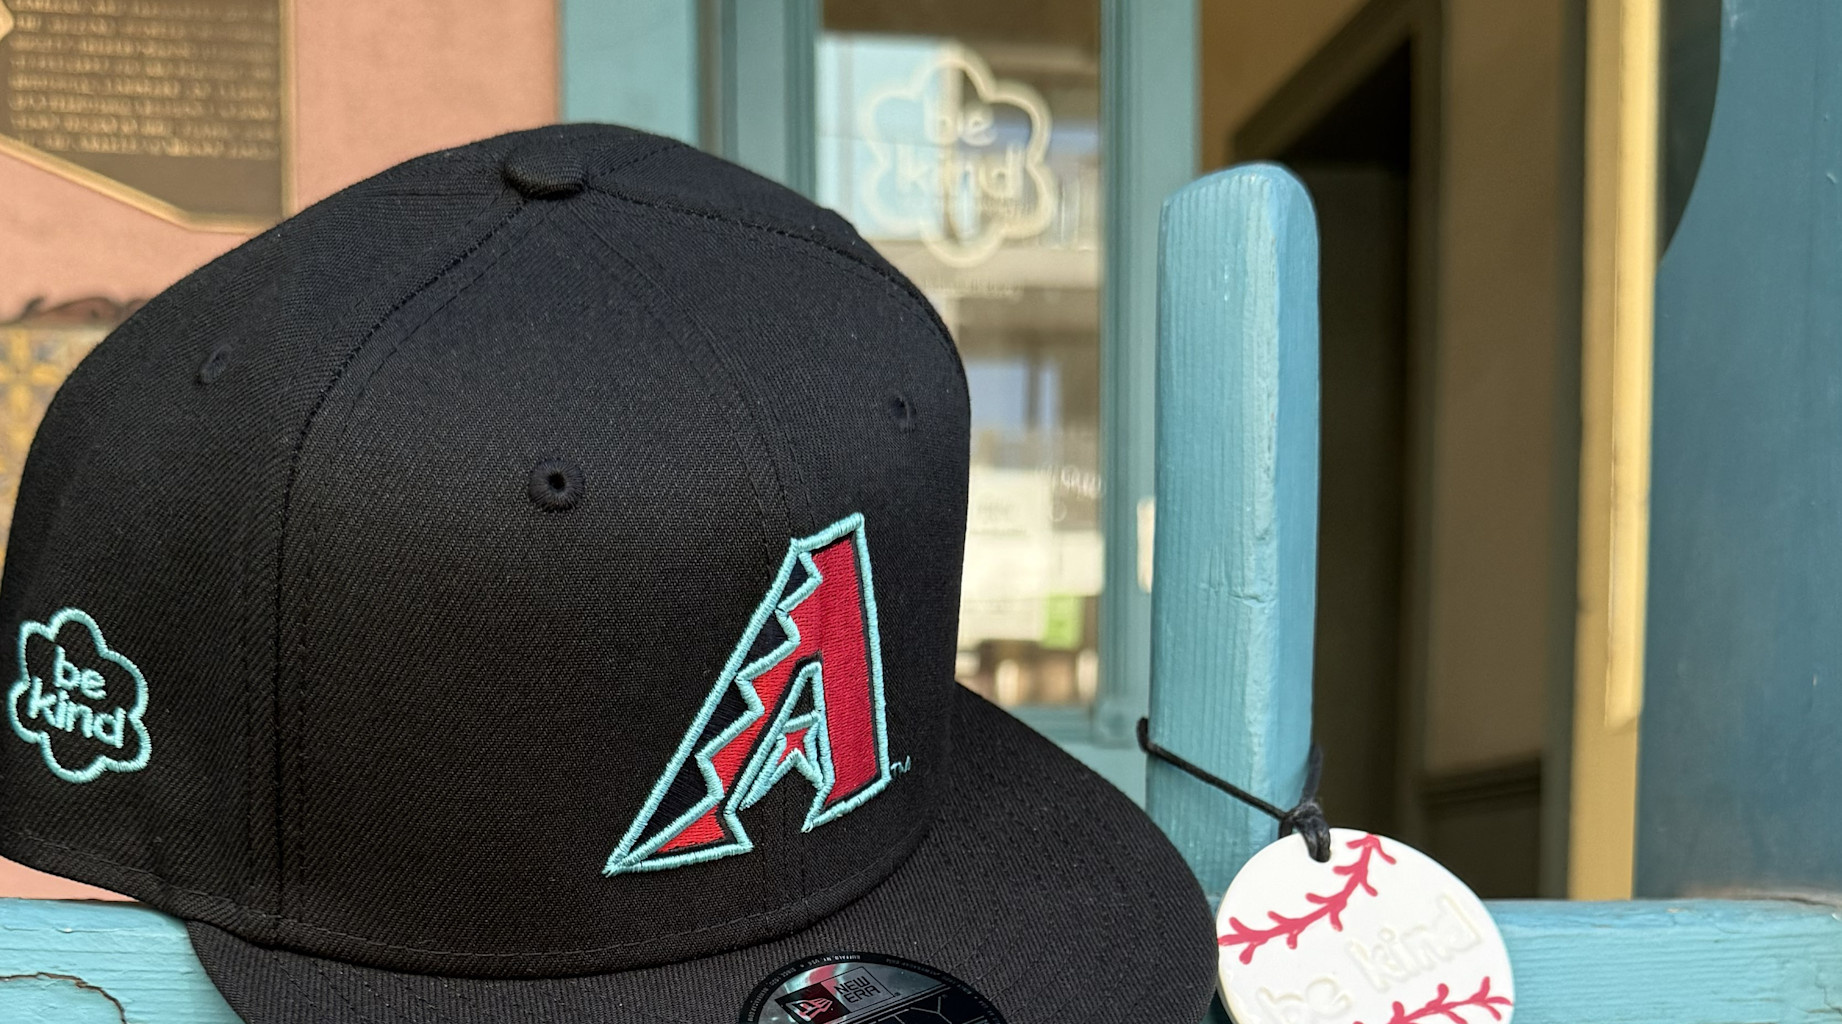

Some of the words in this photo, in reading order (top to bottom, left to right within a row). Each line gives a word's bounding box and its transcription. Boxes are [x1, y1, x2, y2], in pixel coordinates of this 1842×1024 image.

[53, 645, 107, 700] be
[26, 675, 127, 750] kind
[1343, 892, 1484, 995] kind
[833, 975, 871, 996] NEW
[843, 984, 882, 1004] ERA
